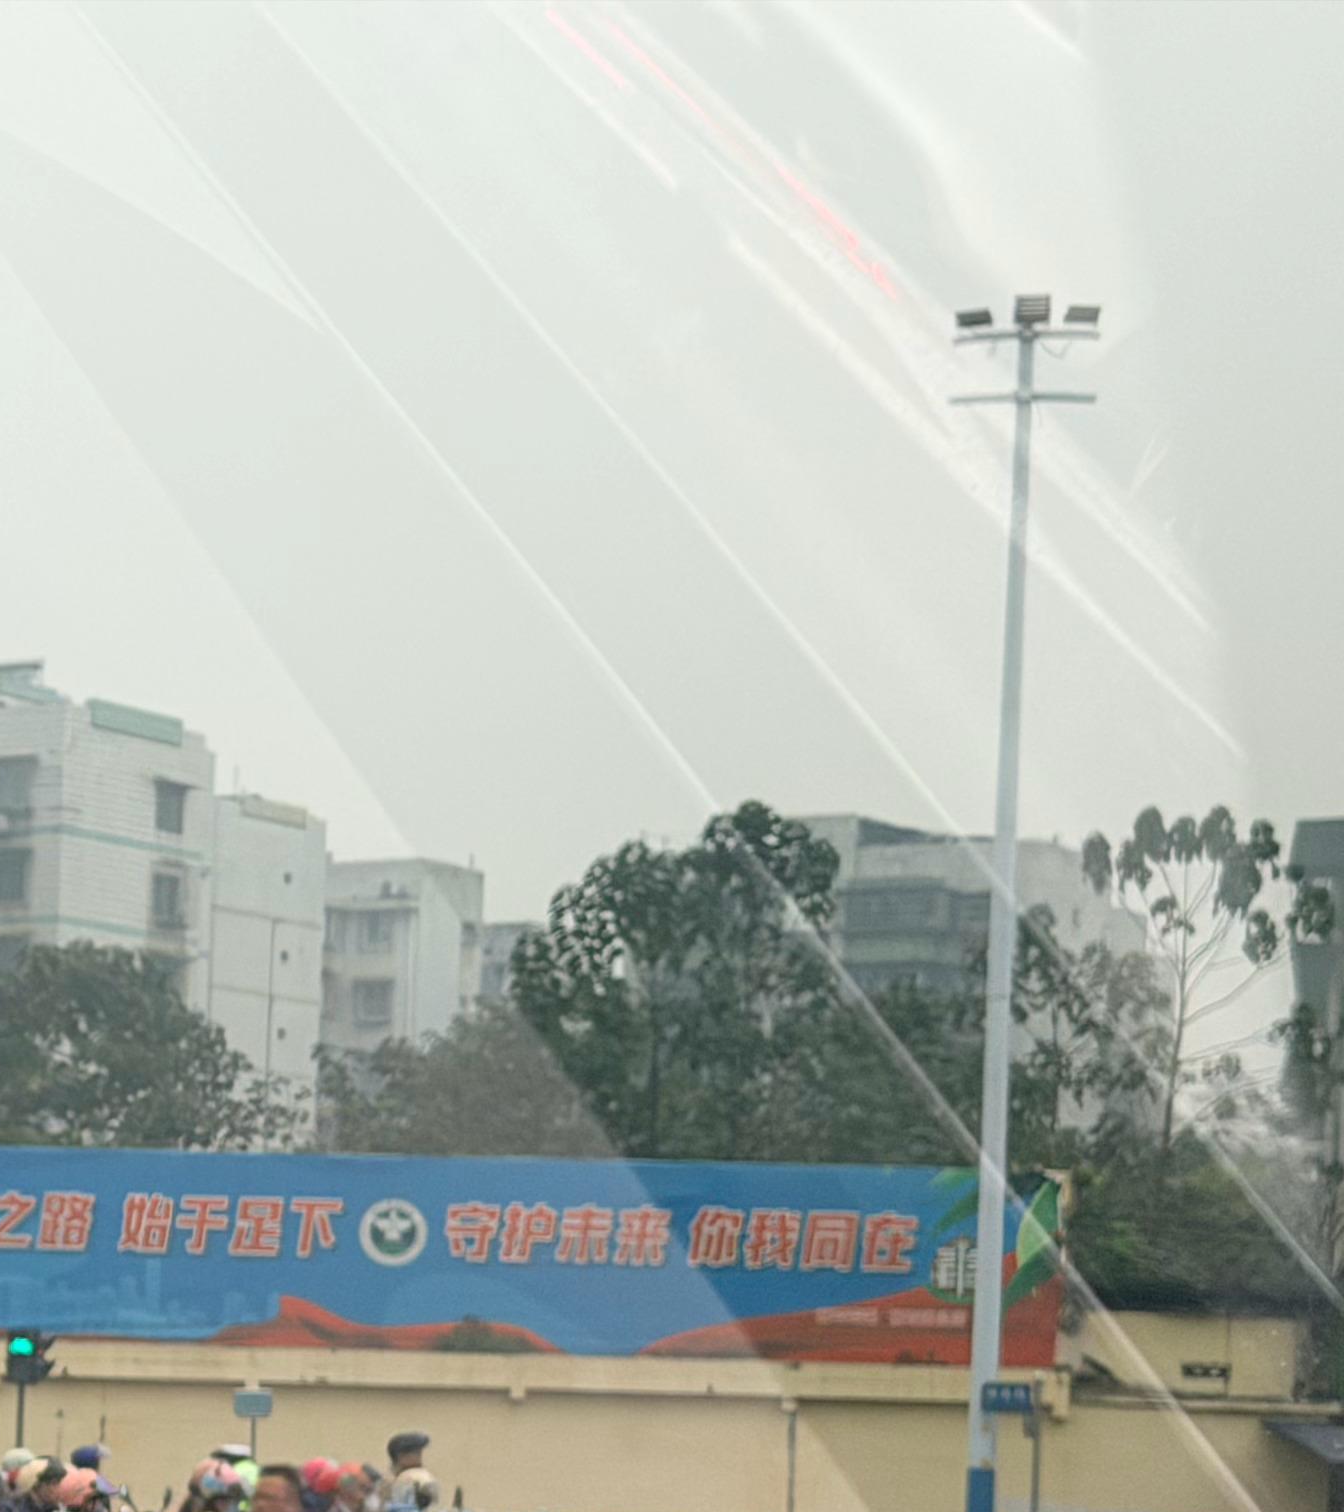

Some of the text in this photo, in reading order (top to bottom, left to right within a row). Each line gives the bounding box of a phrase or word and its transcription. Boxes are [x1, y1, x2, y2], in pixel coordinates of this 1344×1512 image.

[117, 1191, 345, 1258] 始于足下
[444, 1201, 672, 1268] 守护未来
[687, 1204, 920, 1275] 你我同在
